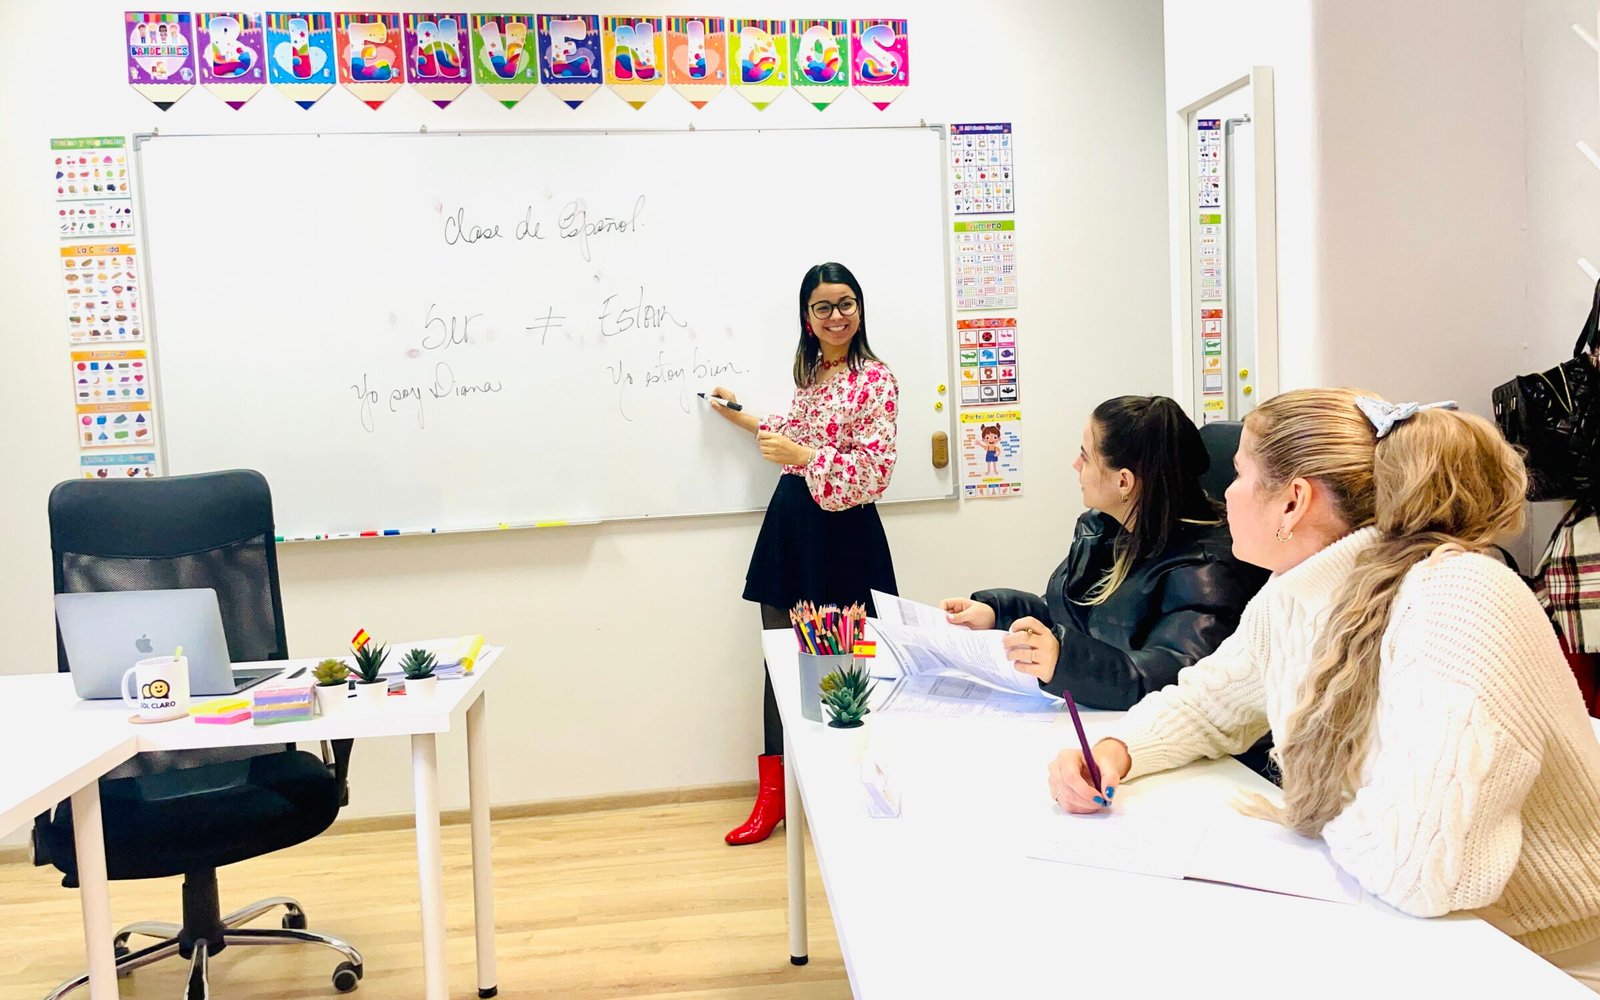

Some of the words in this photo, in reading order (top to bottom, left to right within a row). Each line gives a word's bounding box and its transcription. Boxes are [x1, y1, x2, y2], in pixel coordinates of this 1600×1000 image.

[131, 46, 189, 57] BANDERINES
[209, 17, 900, 83] BIENVENIDOS
[445, 207, 503, 245] Clase
[516, 205, 545, 240] de
[351, 373, 378, 433] Yo
[430, 362, 502, 398] Diana
[151, 701, 176, 709] CLARO
